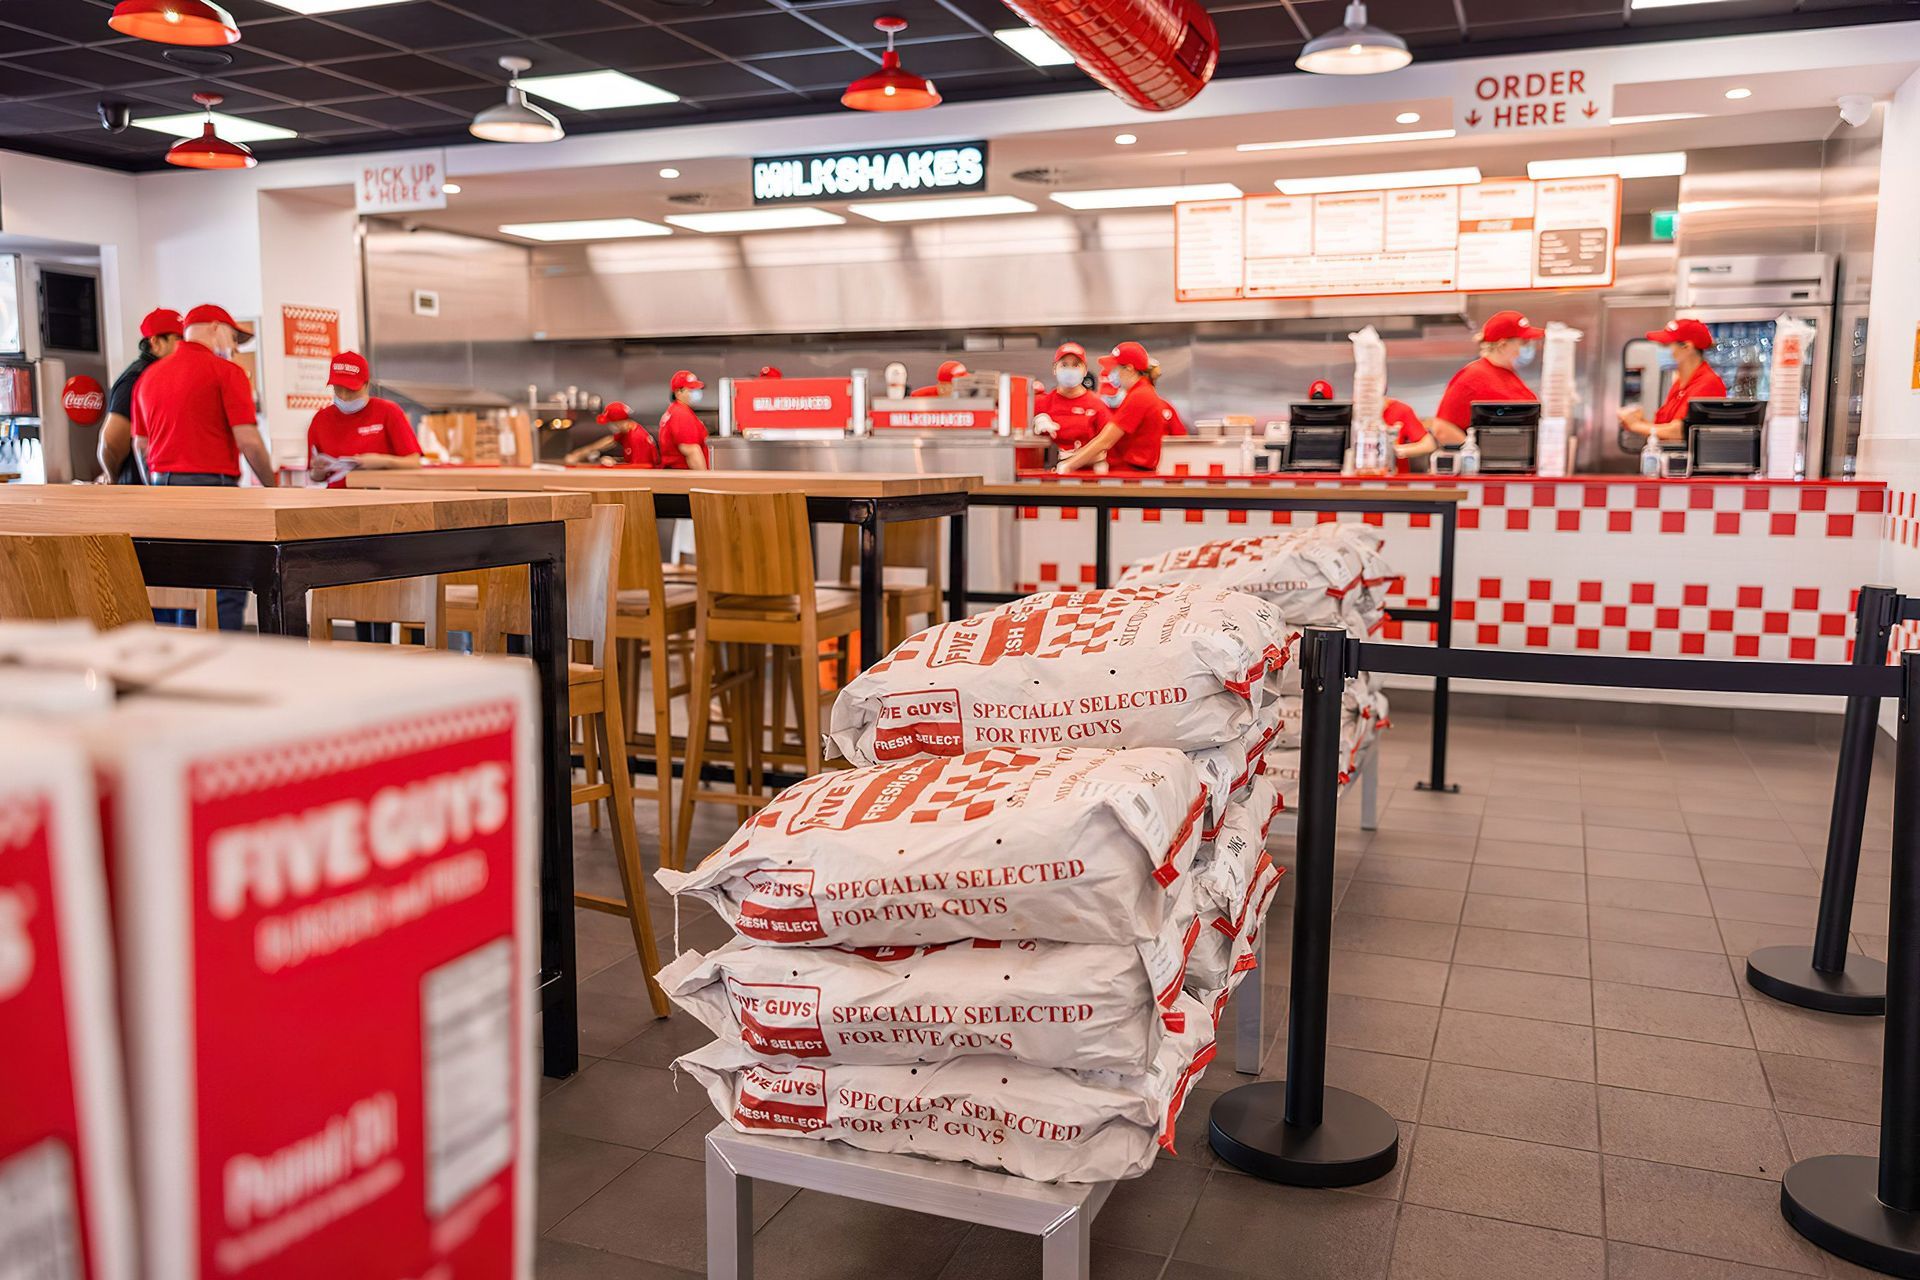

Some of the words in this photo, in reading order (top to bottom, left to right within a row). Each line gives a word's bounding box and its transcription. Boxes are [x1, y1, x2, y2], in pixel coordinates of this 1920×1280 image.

[1476, 70, 1585, 100] ORDER
[1494, 102, 1566, 128] HERE
[364, 166, 404, 187] PICK
[411, 163, 435, 182] UP
[754, 148, 984, 198] MILKSHAKES
[379, 181, 423, 204] HERE
[945, 630, 978, 662] FIVE
[973, 699, 1075, 720] SPECIALLY
[1080, 687, 1187, 714] SELECTED
[875, 735, 913, 750] FRESH
[915, 733, 960, 745] SELECT
[976, 726, 1015, 743] FOR
[1020, 725, 1061, 743] FIVE
[1068, 718, 1122, 740] GUYS
[861, 776, 905, 821] FRESH
[209, 800, 370, 919] FIVE
[370, 763, 507, 867] GUYS
[825, 872, 950, 900] SPECIALLY
[956, 858, 1085, 890] SELECTED
[832, 909, 877, 927] FOR
[884, 902, 937, 921] FIVE
[940, 897, 1008, 918] GUYS
[771, 920, 818, 932] SELECT
[765, 1000, 811, 1018] GUYS
[832, 1005, 961, 1024] SPECIALLY
[964, 1003, 1093, 1025] SELECTED
[770, 1039, 823, 1050] SELECT
[839, 1031, 886, 1046] FOR
[891, 1029, 945, 1047] FIVE
[839, 1116, 883, 1133] FOR
[943, 1121, 1005, 1145] GUYS
[961, 1100, 1082, 1142] SELECTED
